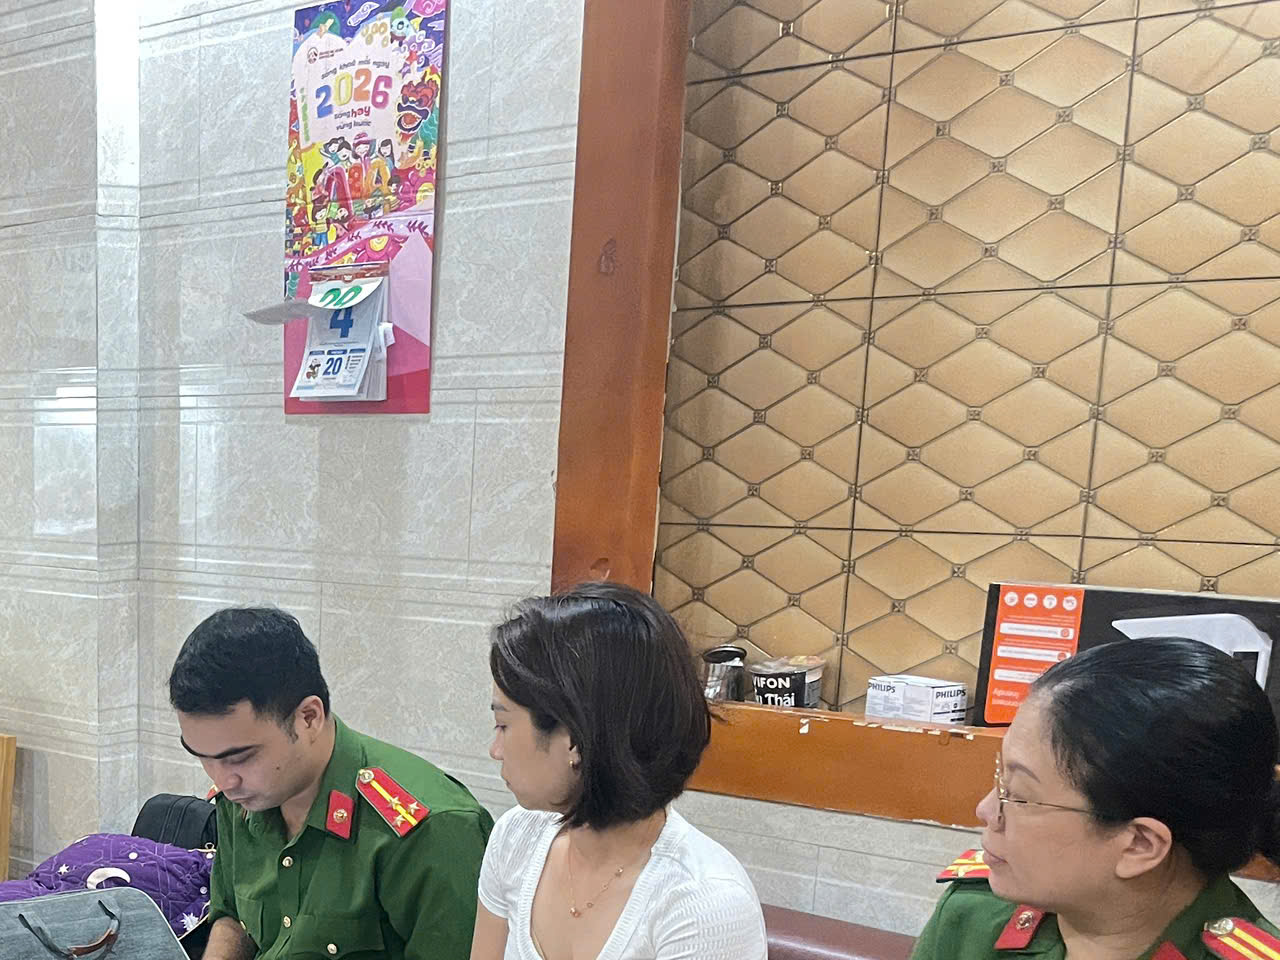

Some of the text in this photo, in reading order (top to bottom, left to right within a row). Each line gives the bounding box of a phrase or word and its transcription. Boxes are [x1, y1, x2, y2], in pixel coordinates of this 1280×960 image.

[316, 68, 393, 118] 2026
[322, 357, 343, 376] 20
[868, 682, 896, 693] PHILIPS
[935, 688, 966, 701] PHILIPS
